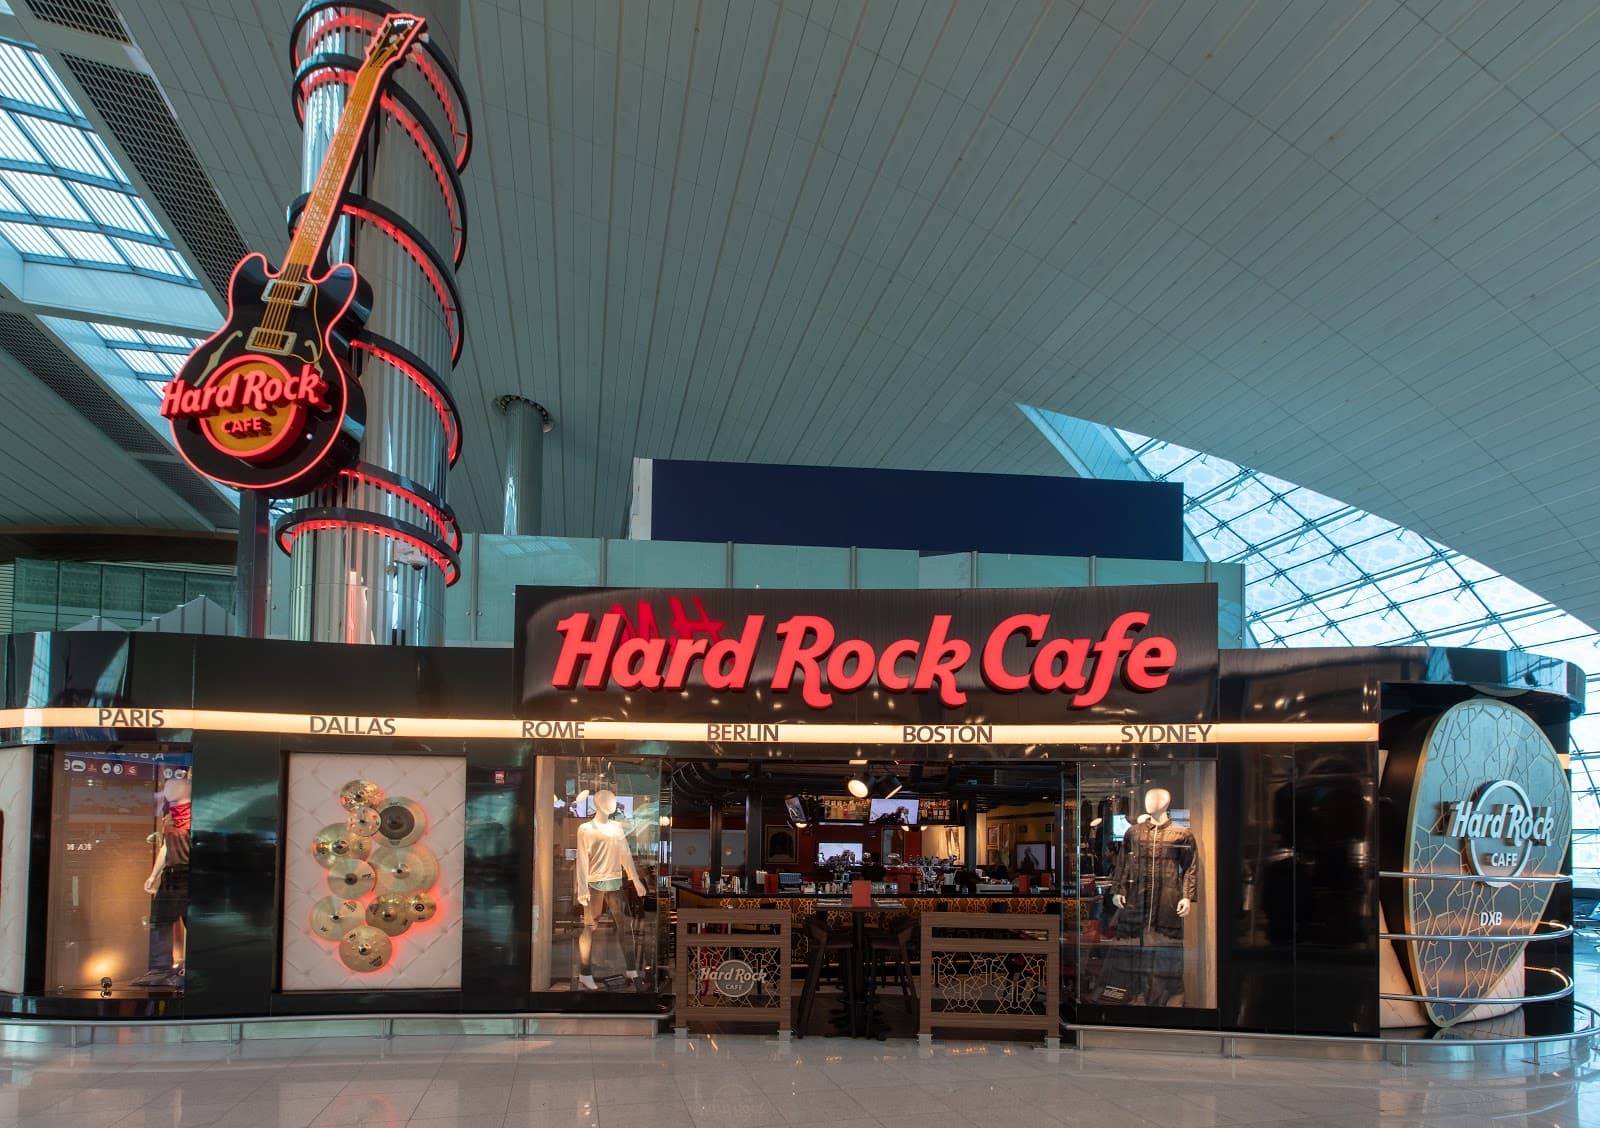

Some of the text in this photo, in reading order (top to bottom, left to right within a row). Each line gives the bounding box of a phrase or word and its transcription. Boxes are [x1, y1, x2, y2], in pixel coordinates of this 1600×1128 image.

[160, 364, 320, 416] Hard Rock
[221, 417, 263, 434] CAFE
[552, 612, 765, 690] Hard
[770, 614, 972, 708] Rock
[981, 611, 1178, 708] Cafe
[99, 708, 165, 729] PARIS
[310, 715, 396, 736] DALLAS
[522, 720, 586, 739] ROME
[707, 722, 780, 743] BERLIN
[903, 723, 993, 744] BOSTON
[1121, 722, 1213, 744] SYDNEY
[1451, 801, 1555, 847] Hard Rock
[1491, 852, 1518, 867] CAFE
[1480, 911, 1503, 926] DXB
[700, 967, 767, 984] Hard Rock
